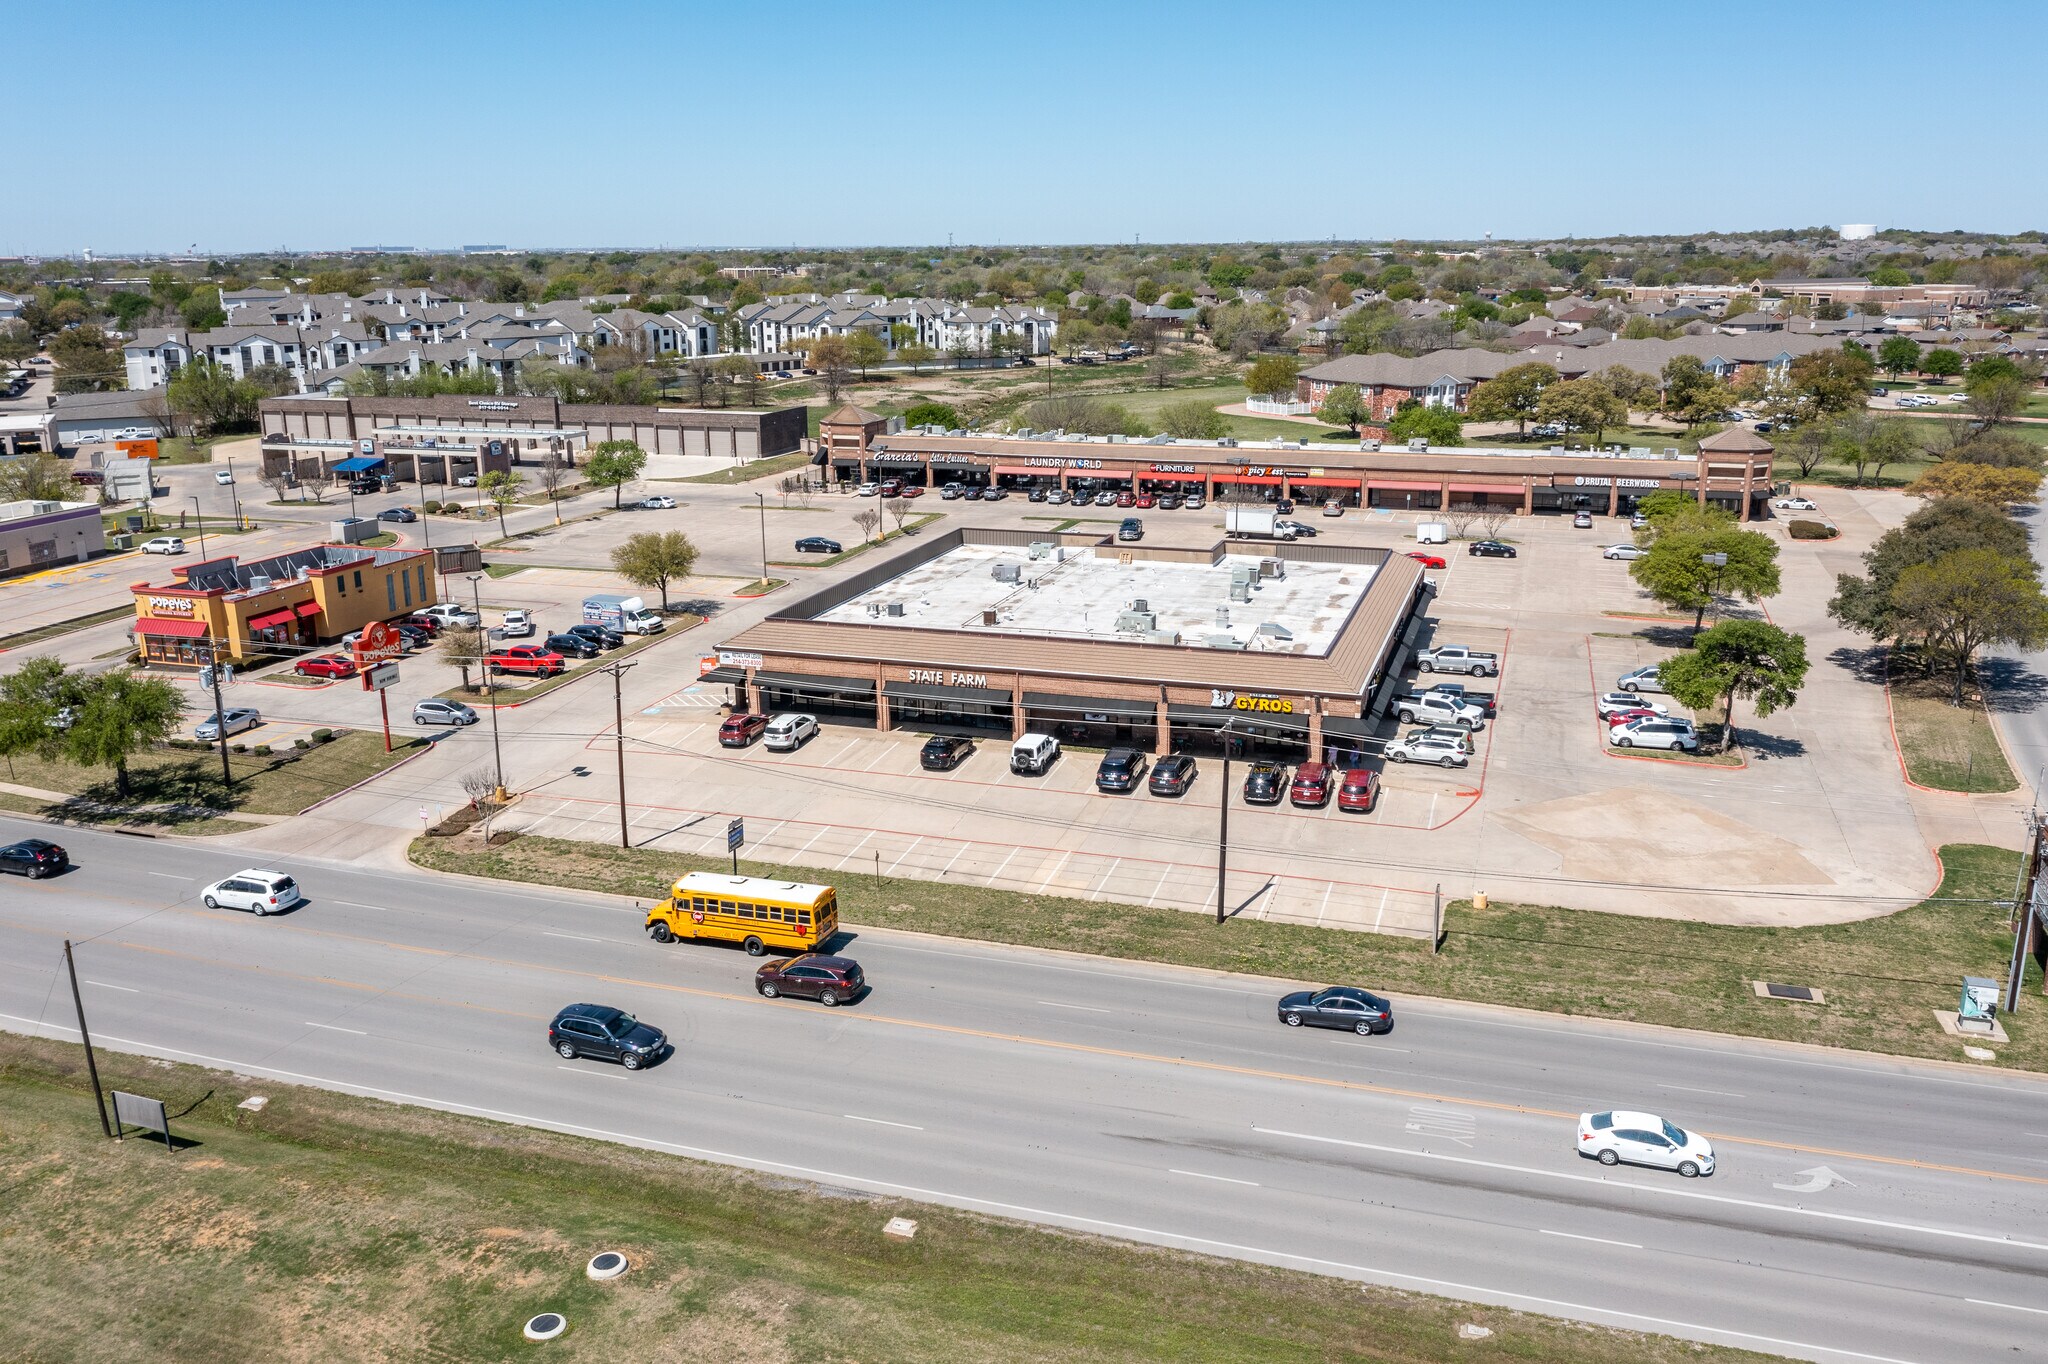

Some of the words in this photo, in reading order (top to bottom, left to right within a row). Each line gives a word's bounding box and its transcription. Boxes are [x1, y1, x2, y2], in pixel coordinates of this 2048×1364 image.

[873, 451, 920, 461] Garcia's
[1024, 457, 1067, 468] LAUNDRY
[1068, 459, 1102, 469] WORLD
[1156, 464, 1195, 473] FURNITURE
[1243, 465, 1266, 476] Spicy
[1265, 467, 1284, 476] Zest
[1584, 477, 1613, 487] BRUTAL
[1616, 478, 1660, 488] BEERWORKS
[909, 669, 943, 683] STATE
[951, 672, 987, 686] FARM
[1236, 697, 1292, 712] GYROS
